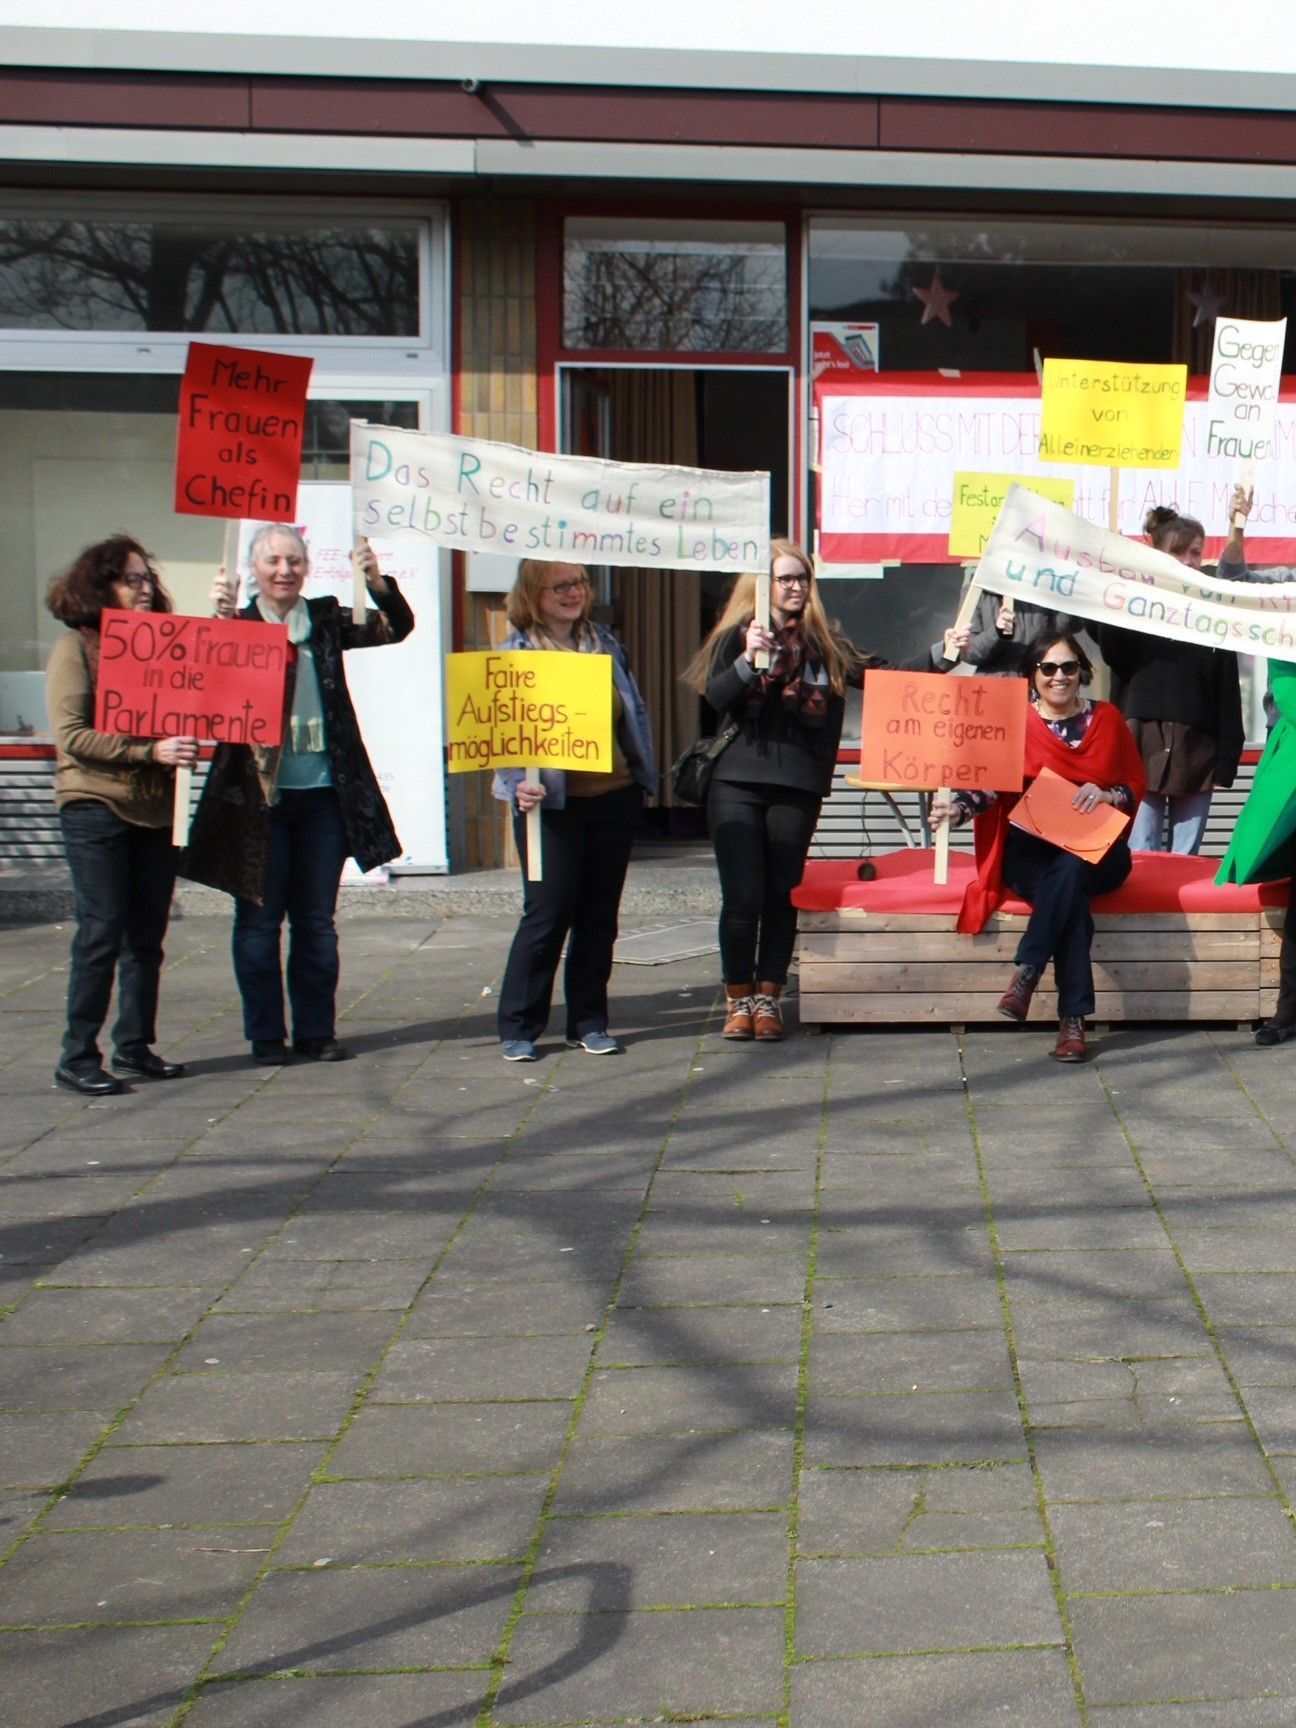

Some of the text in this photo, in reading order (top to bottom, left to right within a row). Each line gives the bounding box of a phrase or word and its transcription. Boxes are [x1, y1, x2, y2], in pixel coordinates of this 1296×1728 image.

[211, 358, 287, 393] Mehr
[1050, 373, 1181, 400] nterstützung
[1213, 363, 1275, 400] Gewa
[188, 393, 298, 438] Frauen
[1092, 408, 1128, 422] von
[1233, 403, 1261, 421] an
[832, 412, 953, 456] SCHLUSS
[958, 412, 996, 456] MIT
[1207, 420, 1273, 460] Frauen
[218, 441, 257, 465] als
[184, 474, 291, 517] Chefin
[366, 439, 713, 521] Das Recht auf ein
[887, 487, 915, 519] mit
[922, 486, 952, 519] de
[1101, 488, 1136, 521] fr
[676, 524, 758, 561] Leben
[1006, 560, 1079, 597] und
[103, 619, 284, 671] 50% Frauen
[143, 665, 204, 690] in die
[485, 657, 536, 689] Faire
[902, 681, 988, 716] Recht
[886, 718, 1006, 747] am eigenen
[882, 749, 988, 787] Körper
